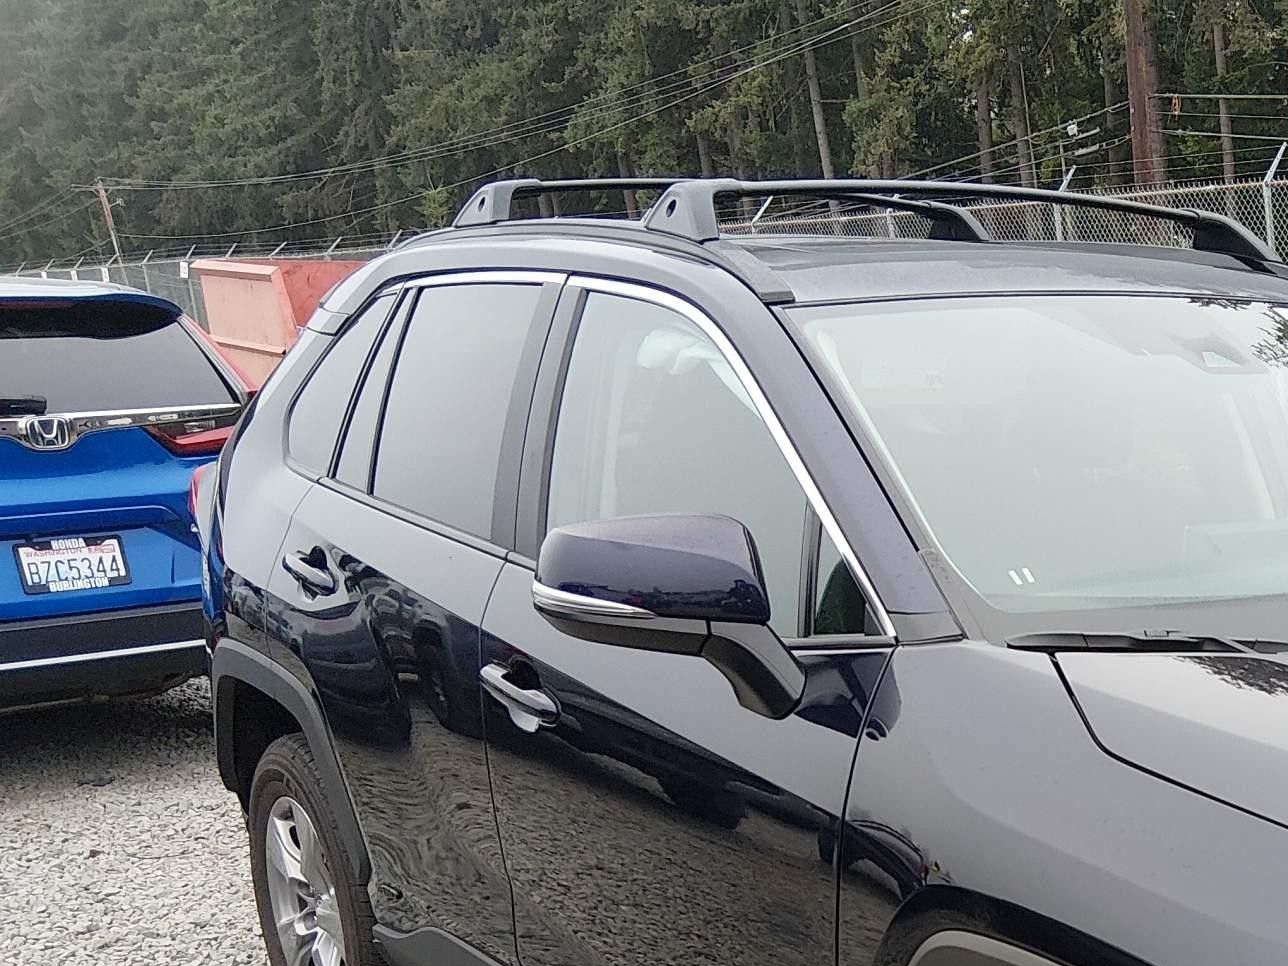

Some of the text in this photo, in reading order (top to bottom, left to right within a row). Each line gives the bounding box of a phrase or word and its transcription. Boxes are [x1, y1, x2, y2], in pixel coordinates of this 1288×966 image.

[50, 538, 86, 550] HONDA
[27, 555, 120, 585] BZC5344
[48, 576, 109, 592] BURLINGTON
